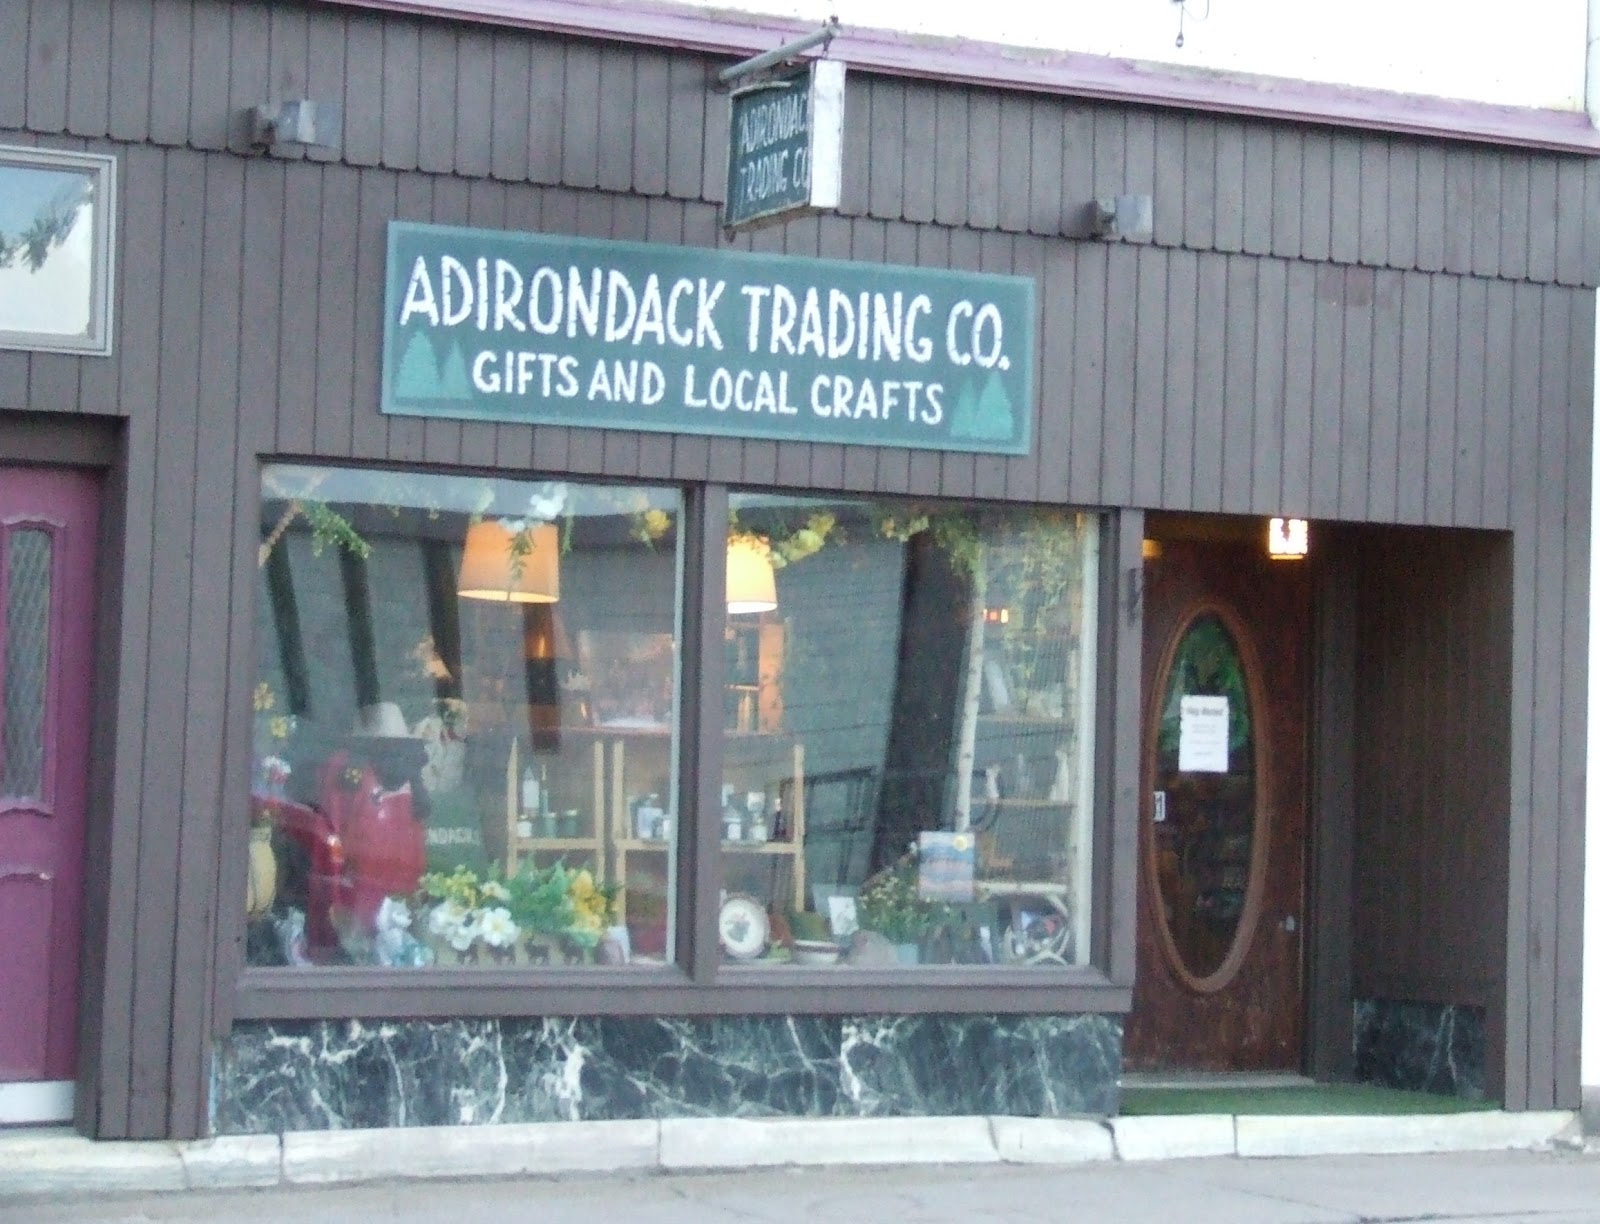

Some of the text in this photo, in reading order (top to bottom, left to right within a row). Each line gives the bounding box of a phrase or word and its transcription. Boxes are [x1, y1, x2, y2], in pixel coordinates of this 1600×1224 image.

[740, 92, 807, 154] ADIRONDAC
[739, 148, 789, 204] TRADING
[400, 254, 1011, 372] ADIRONDACK TRADING CO.
[472, 350, 944, 425] GIFTS AND LOCAL CRAFTS
